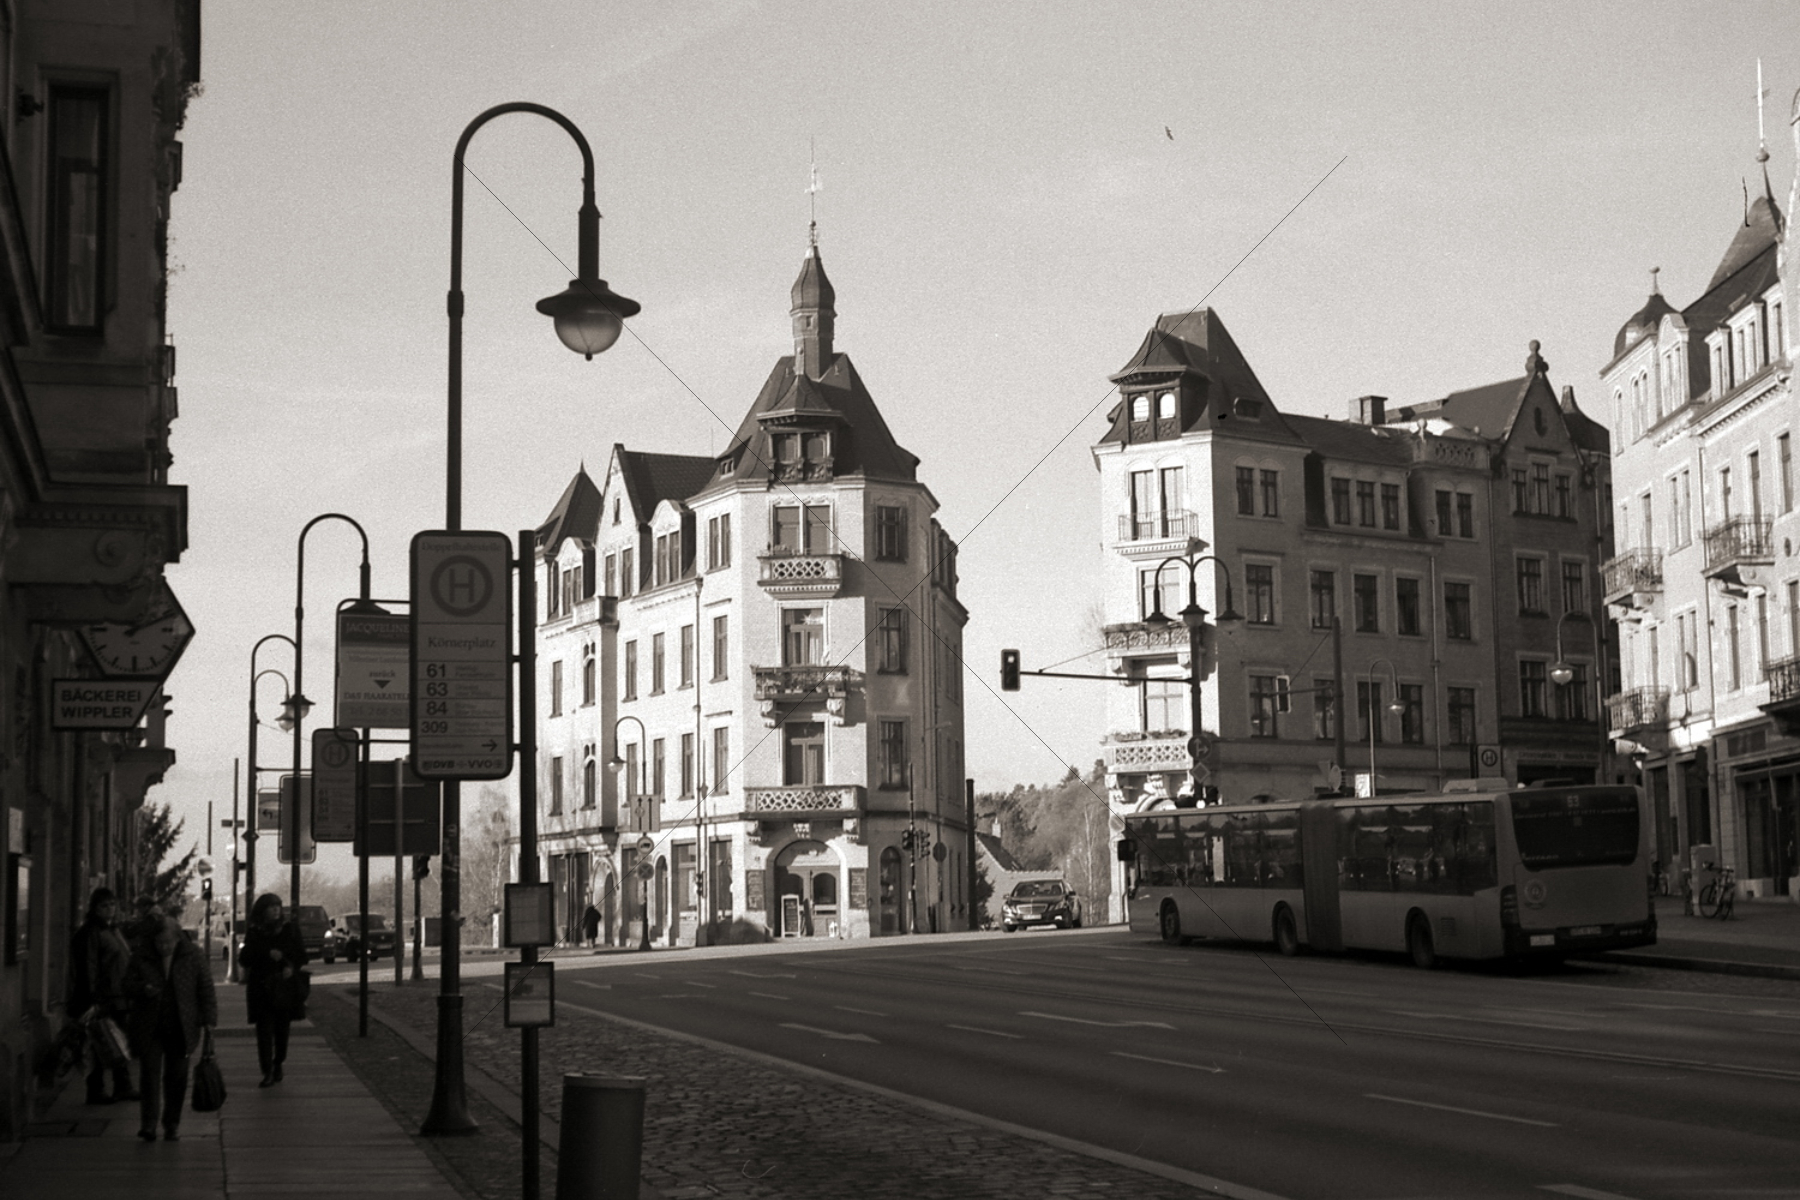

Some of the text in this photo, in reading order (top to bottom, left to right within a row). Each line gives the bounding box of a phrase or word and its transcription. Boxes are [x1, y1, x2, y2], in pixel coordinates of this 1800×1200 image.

[428, 636, 496, 651] Körnerplatz
[426, 663, 446, 678] 61
[61, 688, 142, 702] BÄCKEREI
[426, 682, 448, 697] 63
[61, 706, 133, 719] WIPPLER
[426, 701, 448, 716] 84
[421, 721, 448, 734] 309
[433, 760, 493, 769] DVB VVO
